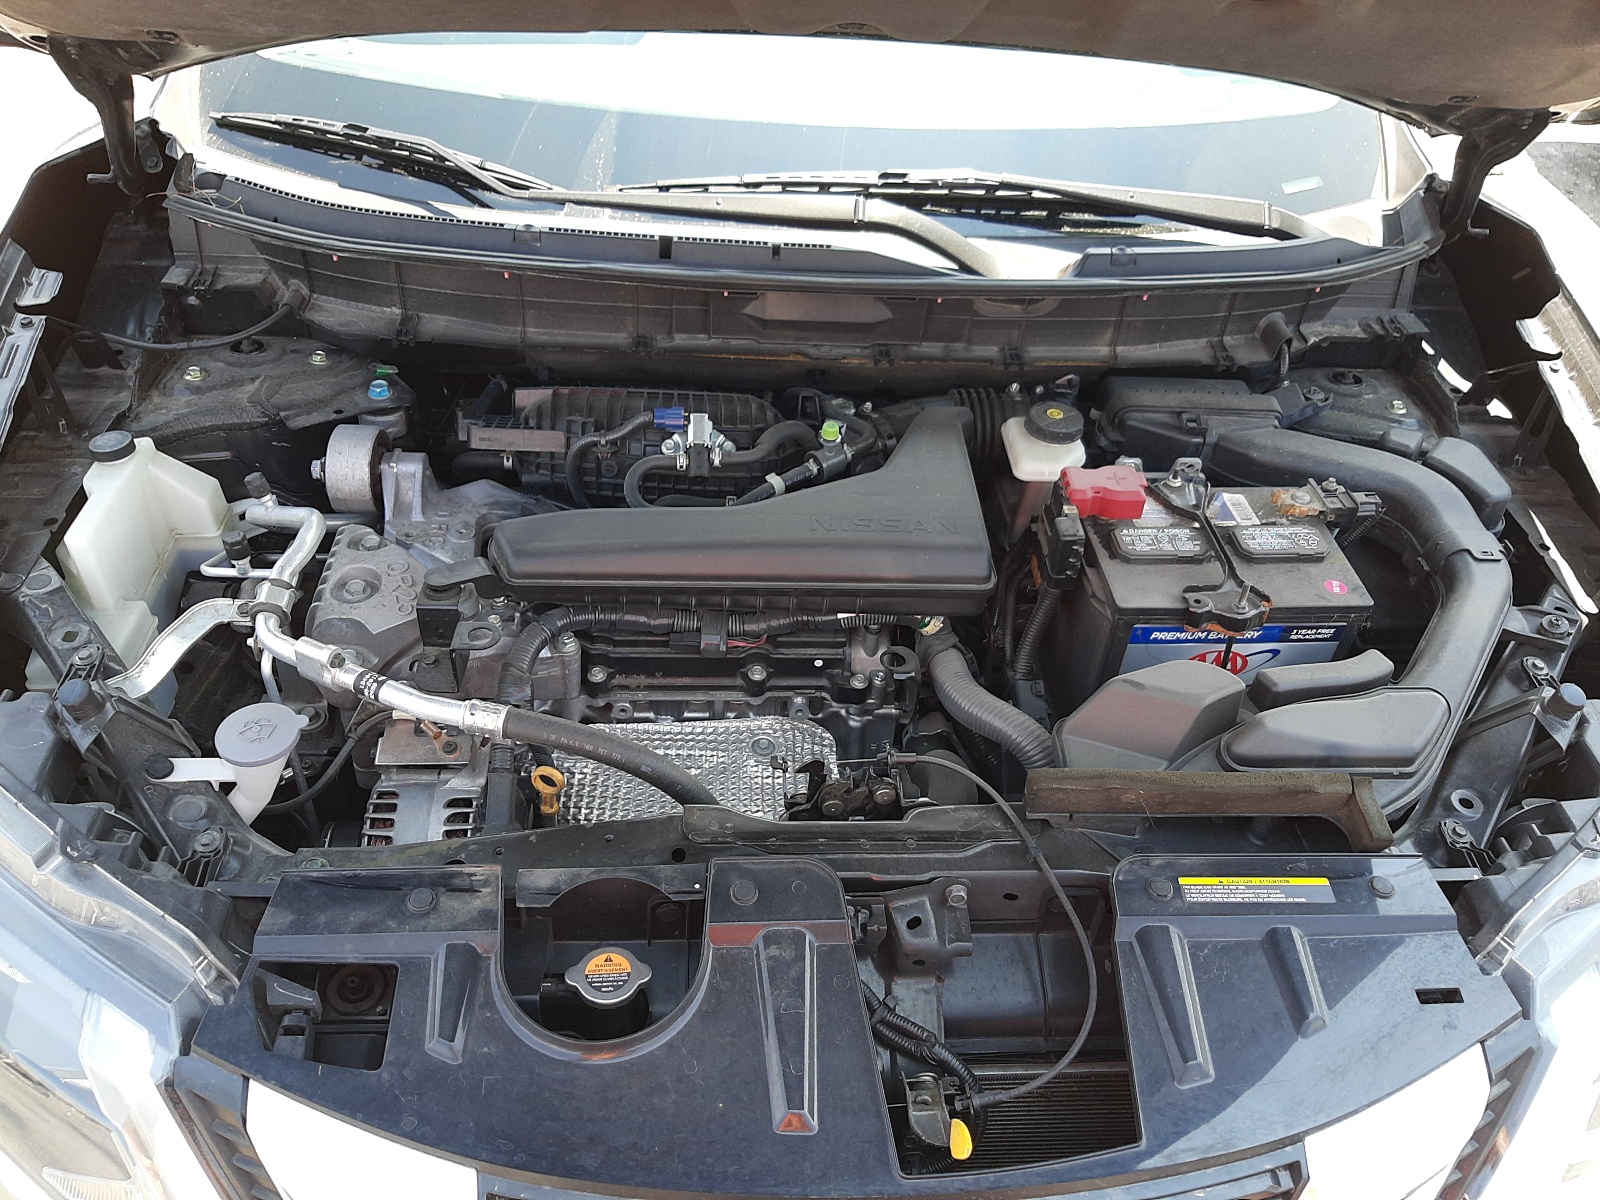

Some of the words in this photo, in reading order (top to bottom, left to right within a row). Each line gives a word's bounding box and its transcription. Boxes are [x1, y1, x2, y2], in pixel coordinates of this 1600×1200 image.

[810, 515, 964, 534] NISSAN
[1150, 631, 1208, 640] PREMIUM
[1208, 630, 1263, 640] BARY
